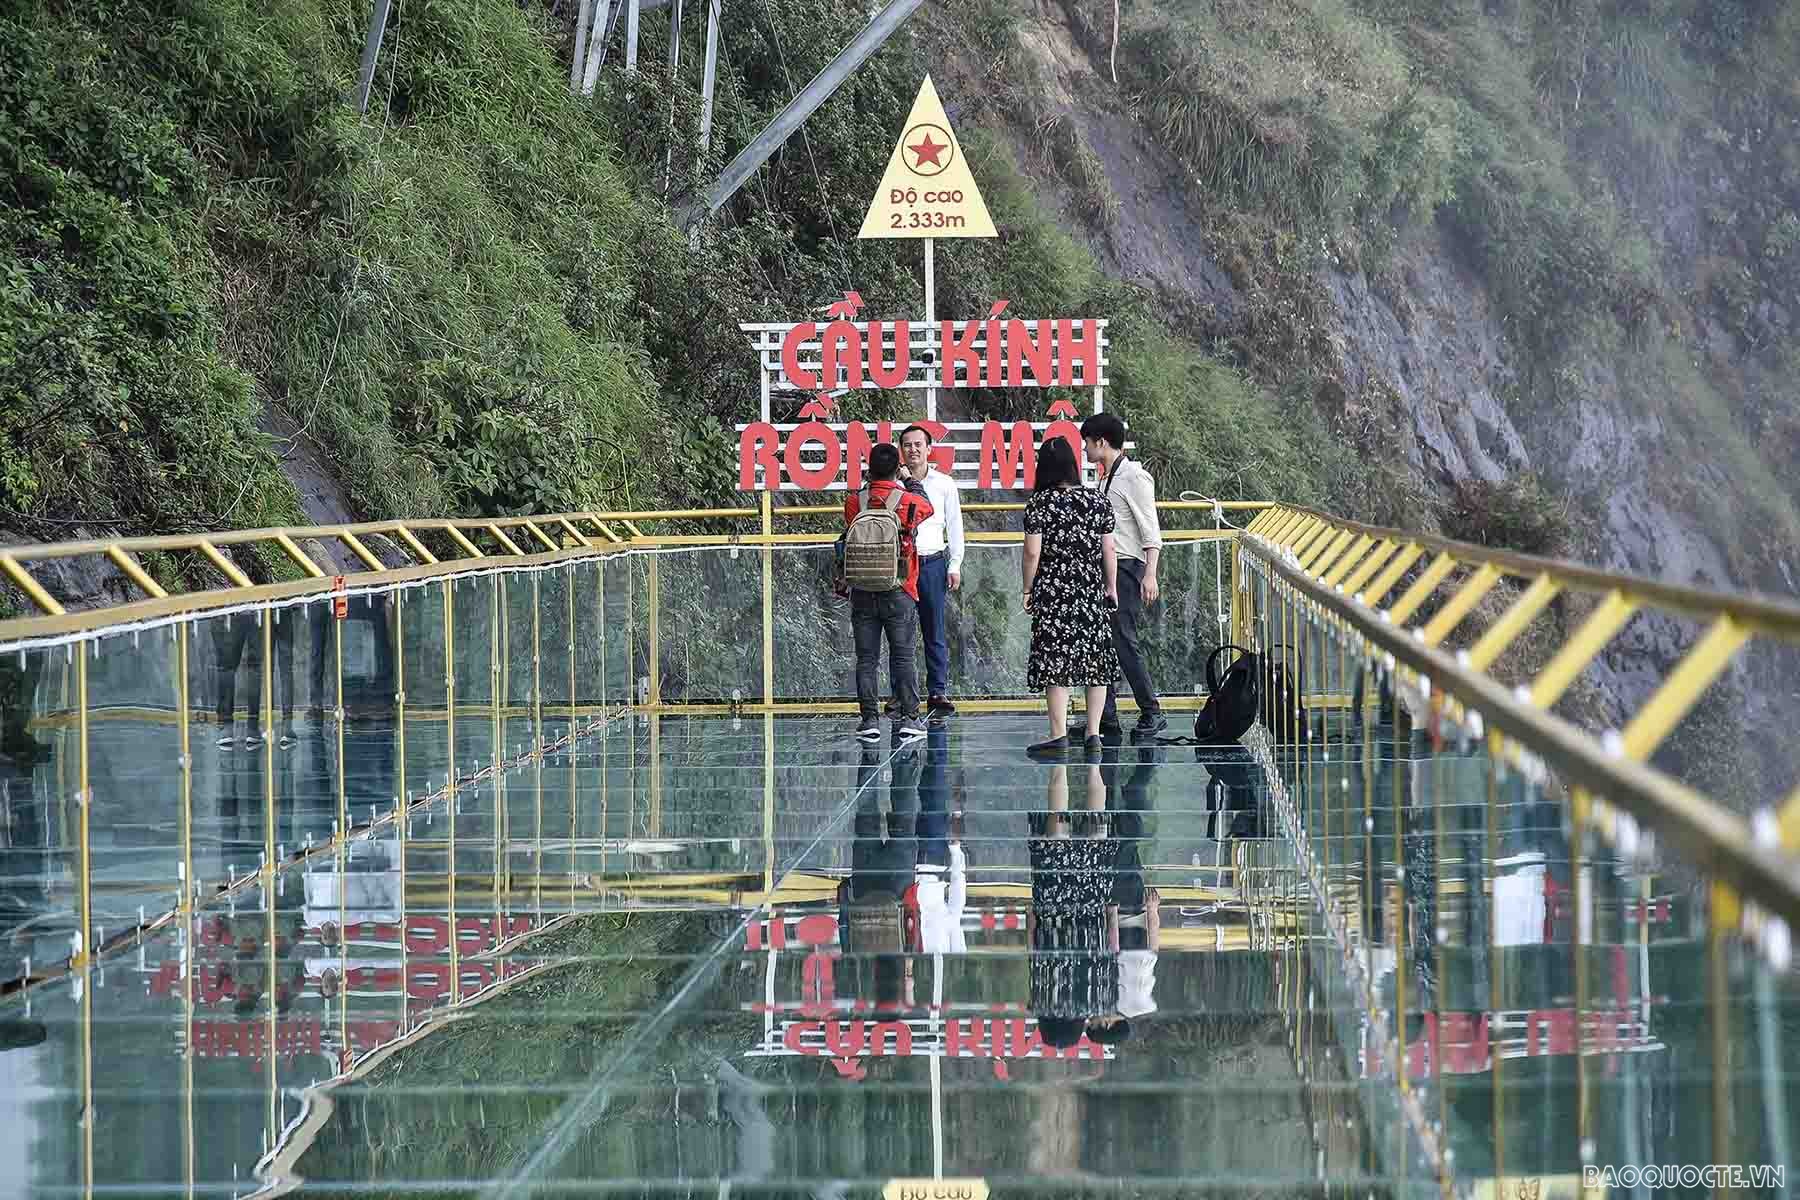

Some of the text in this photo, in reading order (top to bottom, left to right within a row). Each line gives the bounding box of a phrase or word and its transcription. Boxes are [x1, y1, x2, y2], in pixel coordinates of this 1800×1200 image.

[890, 186, 964, 208] Độ cao
[890, 212, 966, 229] 2.333m
[782, 290, 1098, 390] CẦU KÍNH
